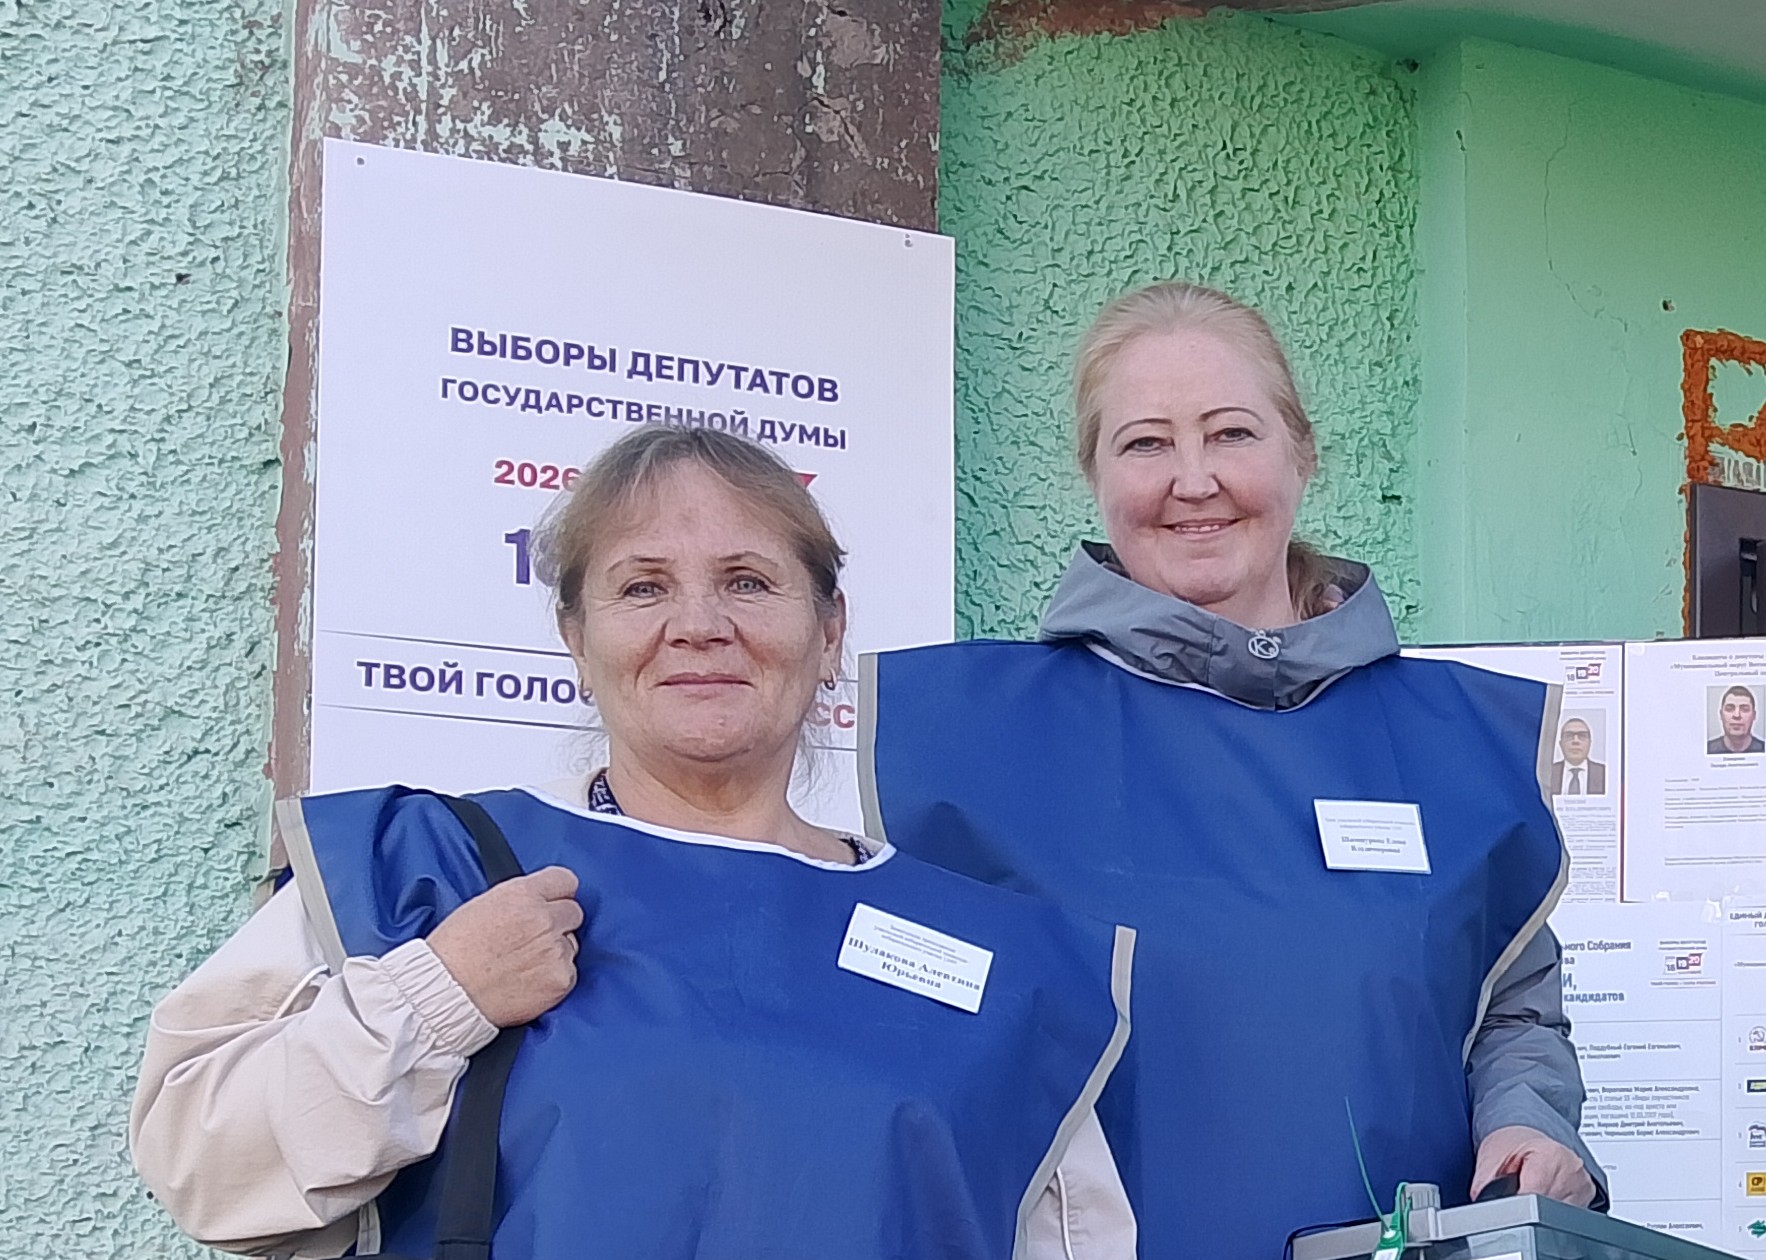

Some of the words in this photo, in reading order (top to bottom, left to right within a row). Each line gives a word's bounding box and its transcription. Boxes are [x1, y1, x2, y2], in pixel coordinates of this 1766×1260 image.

[450, 326, 617, 373] ВЫБОРЫ
[627, 350, 840, 403] ДЕПУТАТОВ
[441, 377, 748, 436] ГОСУДАРСТВЕННОЙ
[757, 417, 847, 450] ДУМЫ
[357, 661, 463, 695] ТВОЙ
[476, 671, 594, 706] ГОЛО
[1730, 911, 1762, 920] ЕДИНЫЙ
[849, 937, 916, 968] Шулакова
[918, 963, 980, 991] Алевтина
[1587, 940, 1632, 952] Собрания
[881, 961, 942, 989] Юрьевна
[1564, 991, 1624, 1003] кандидатов
